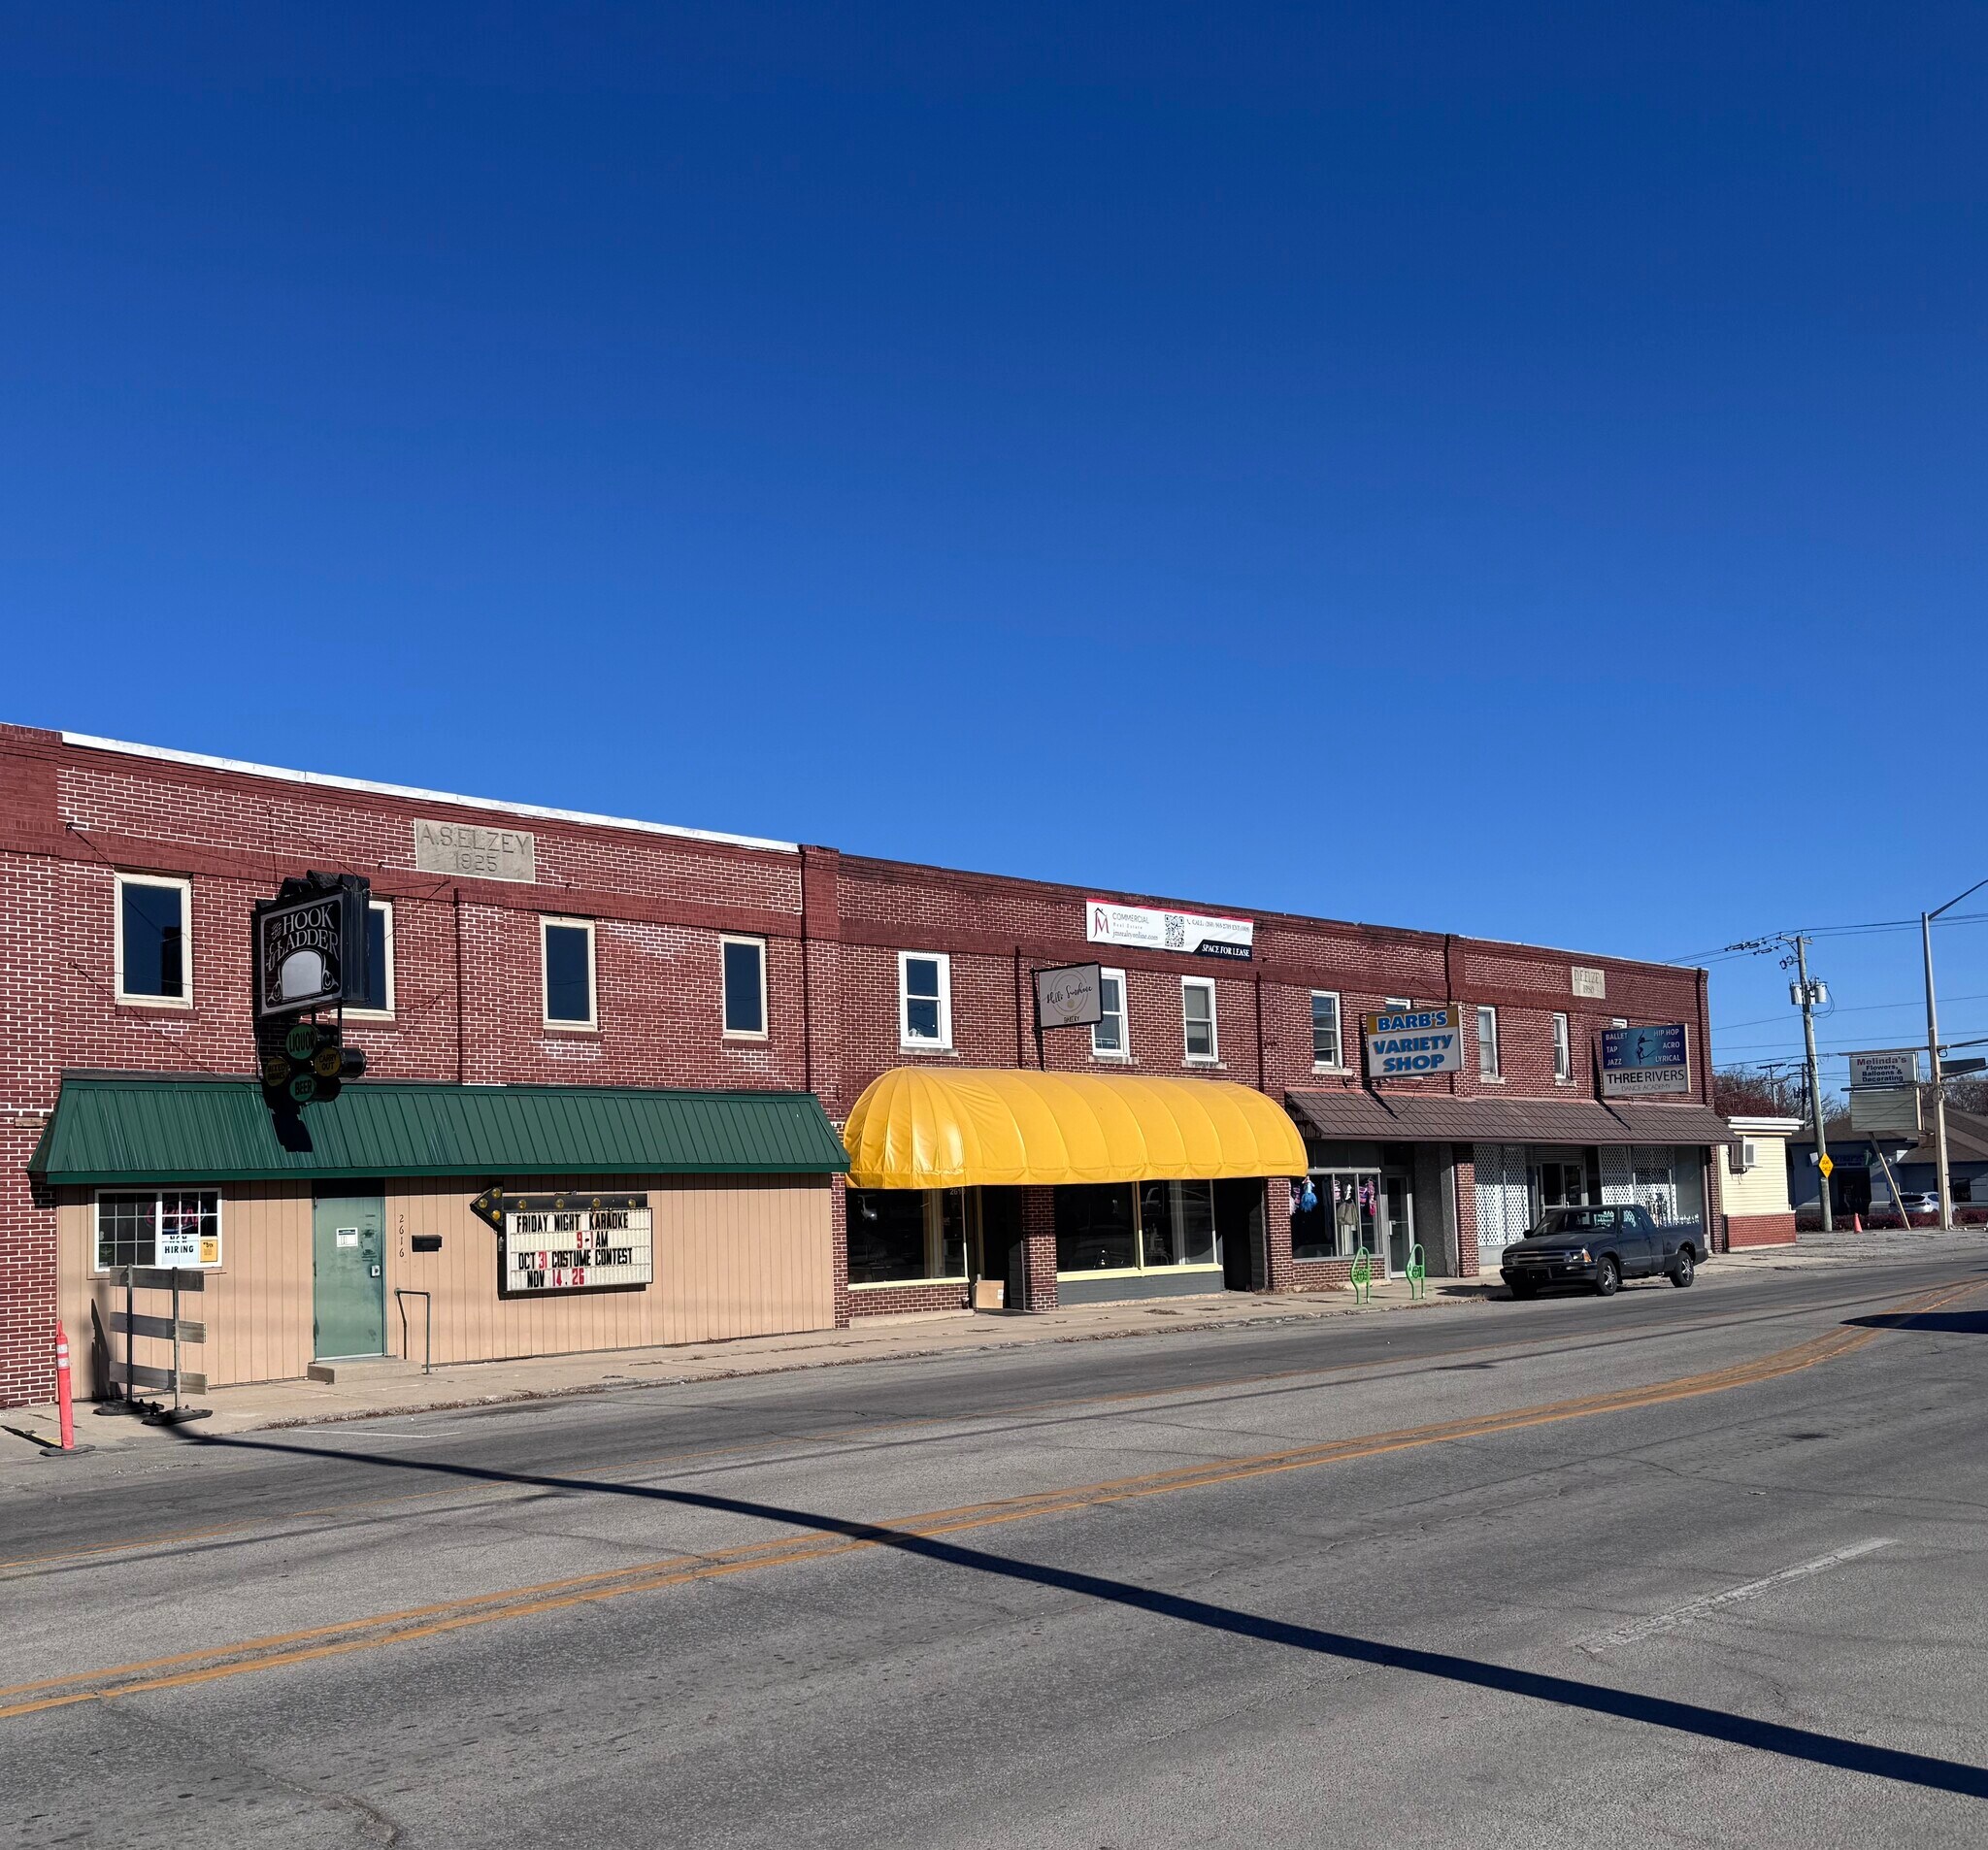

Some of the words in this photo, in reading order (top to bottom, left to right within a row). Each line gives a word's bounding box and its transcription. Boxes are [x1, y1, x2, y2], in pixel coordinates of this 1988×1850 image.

[454, 850, 497, 872] 1925
[282, 904, 335, 936] HOOK
[1112, 912, 1149, 924] COMMERCIAL
[276, 929, 340, 962] LADDER
[1202, 943, 1220, 954] SPACE
[1220, 946, 1233, 955] FOR
[1233, 948, 1250, 957] LEASE
[1066, 981, 1093, 999] Sunshine
[1063, 1015, 1080, 1024] BAKERY
[1377, 1010, 1447, 1032] BARB'S
[288, 1031, 315, 1053] LIQUOR
[1373, 1035, 1454, 1055] VARIETY
[1606, 1032, 1628, 1041] BALLET
[321, 1062, 335, 1071] OUT
[1382, 1053, 1445, 1073] SHOP
[1655, 1054, 1680, 1063] LYRICAL
[1857, 1056, 1906, 1066] Melinda's
[1607, 1072, 1643, 1084] THREE
[1644, 1070, 1685, 1082] RIVERS
[294, 1079, 313, 1096] BEER
[516, 1214, 548, 1233] FRIDAY
[554, 1213, 580, 1231] NIGHT
[589, 1211, 628, 1230] KARAOKE
[164, 1245, 194, 1254] HIRING
[518, 1252, 536, 1270] OCT
[539, 1250, 547, 1269] 31
[552, 1249, 591, 1268] COSTUME
[595, 1247, 633, 1266] CONTEST
[527, 1271, 545, 1288] NOV
[572, 1268, 584, 1285] 26
